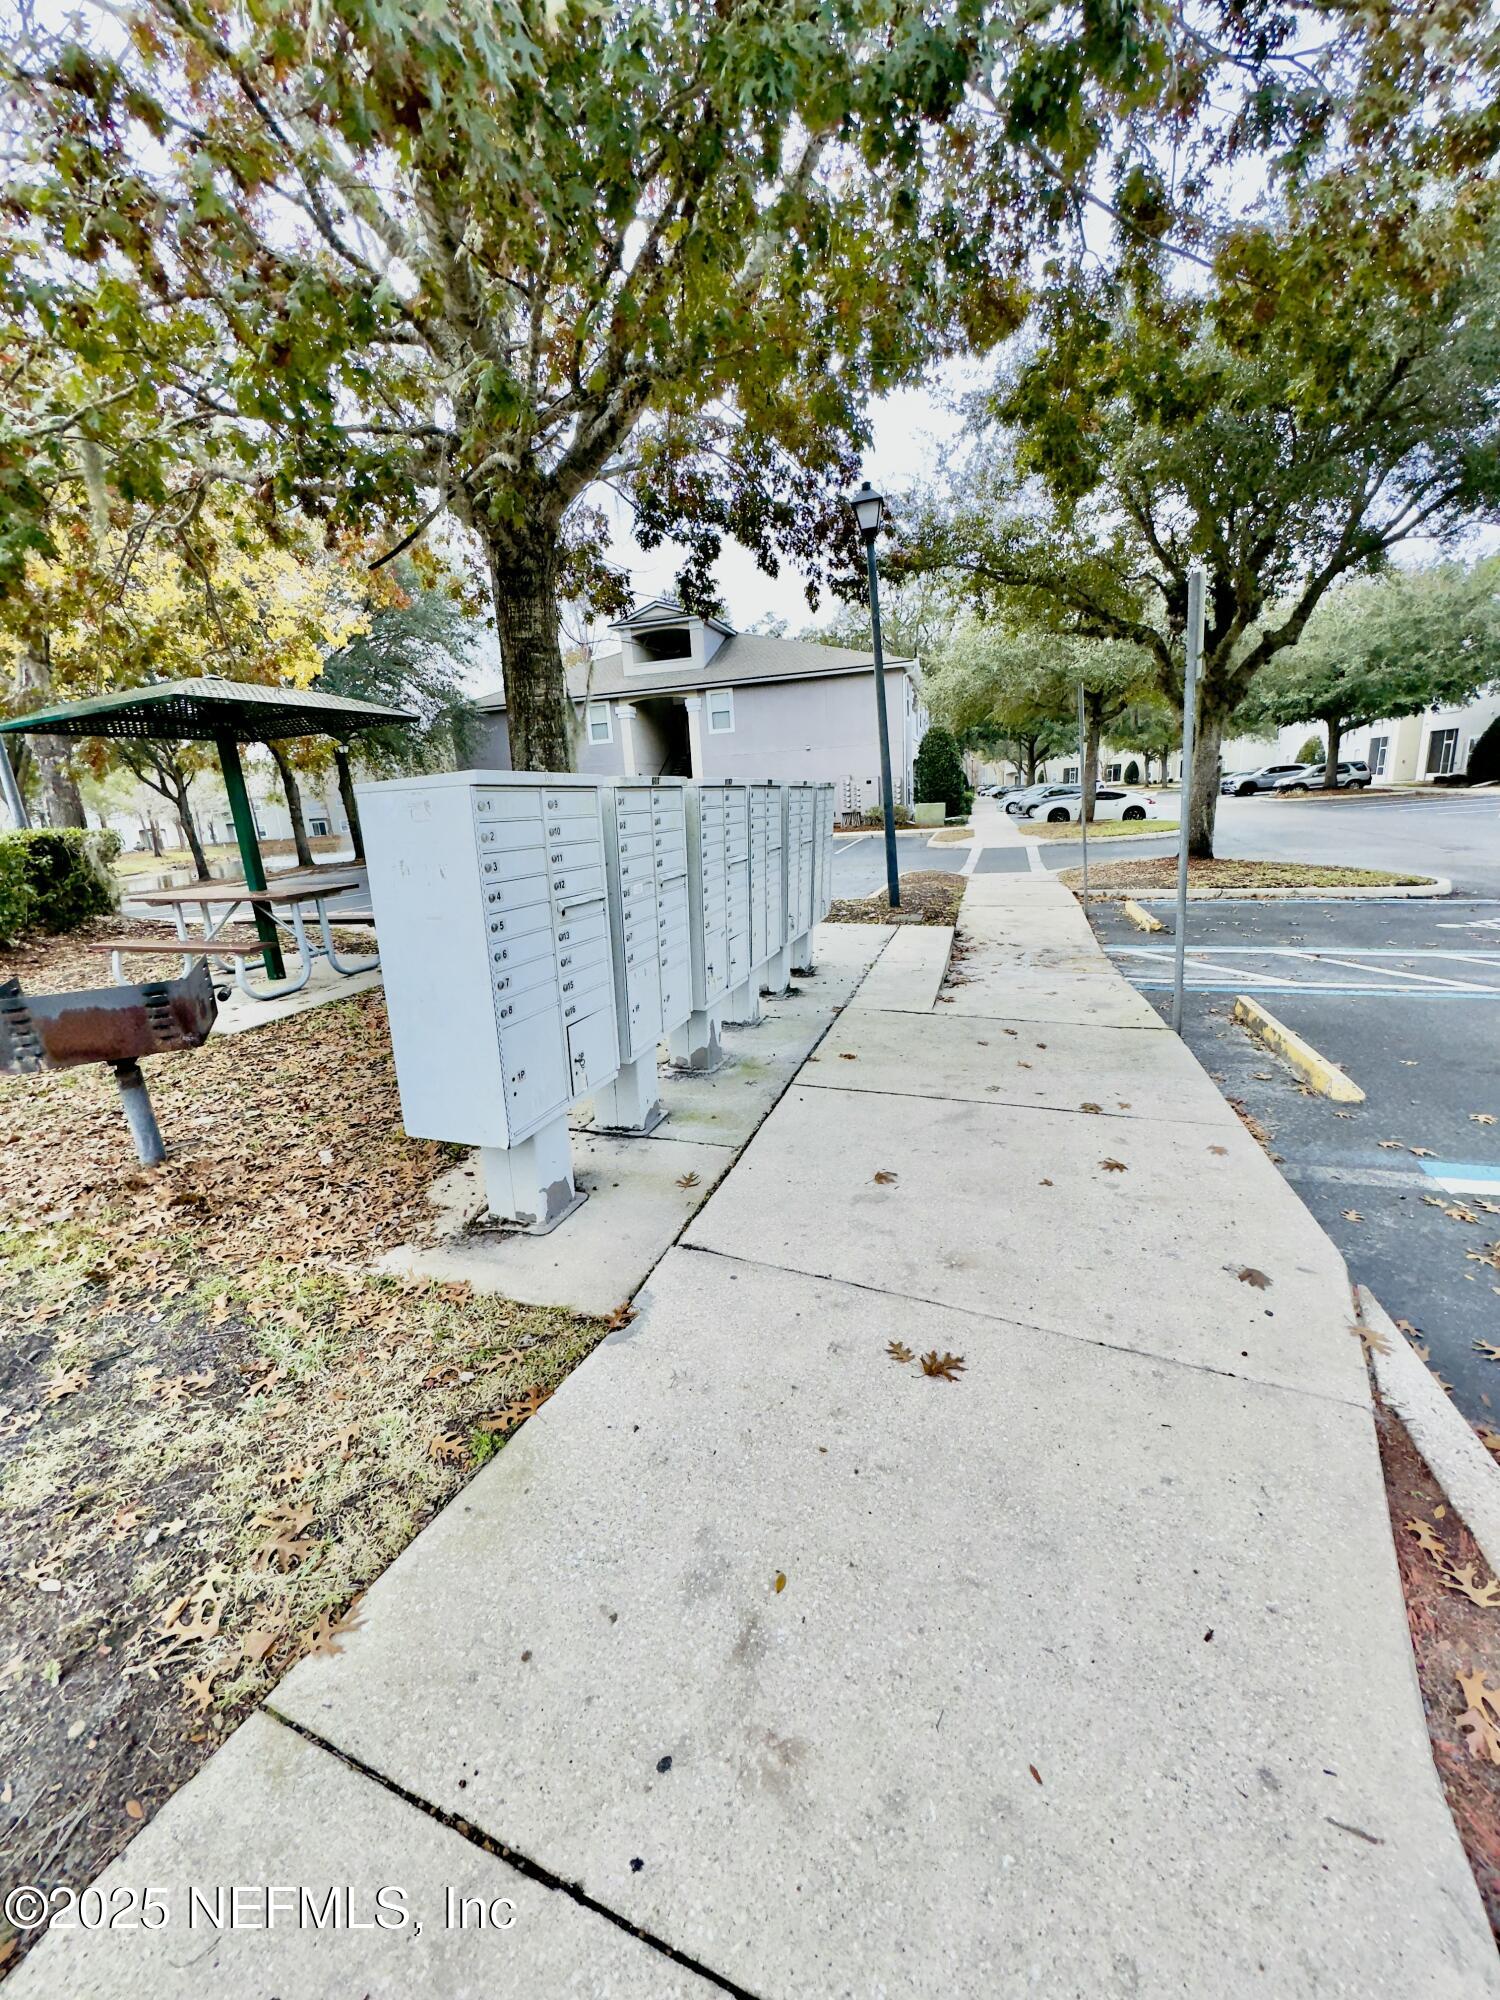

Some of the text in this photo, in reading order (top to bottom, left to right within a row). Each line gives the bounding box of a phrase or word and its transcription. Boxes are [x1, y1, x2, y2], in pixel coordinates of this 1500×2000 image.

[487, 801, 491, 810] 1
[553, 827, 561, 836] 10
[490, 832, 495, 841] 2
[556, 854, 563, 863] 11
[493, 863, 498, 872] 3
[558, 880, 565, 889] 12
[497, 892, 501, 900] 4
[499, 921, 504, 931] 5
[563, 931, 570, 941] 13
[502, 949, 507, 959] 6
[505, 978, 510, 987] 7
[568, 980, 574, 990] 15
[508, 1005, 513, 1015] 8
[570, 1005, 576, 1015] 16
[518, 1070, 526, 1081] 1P
